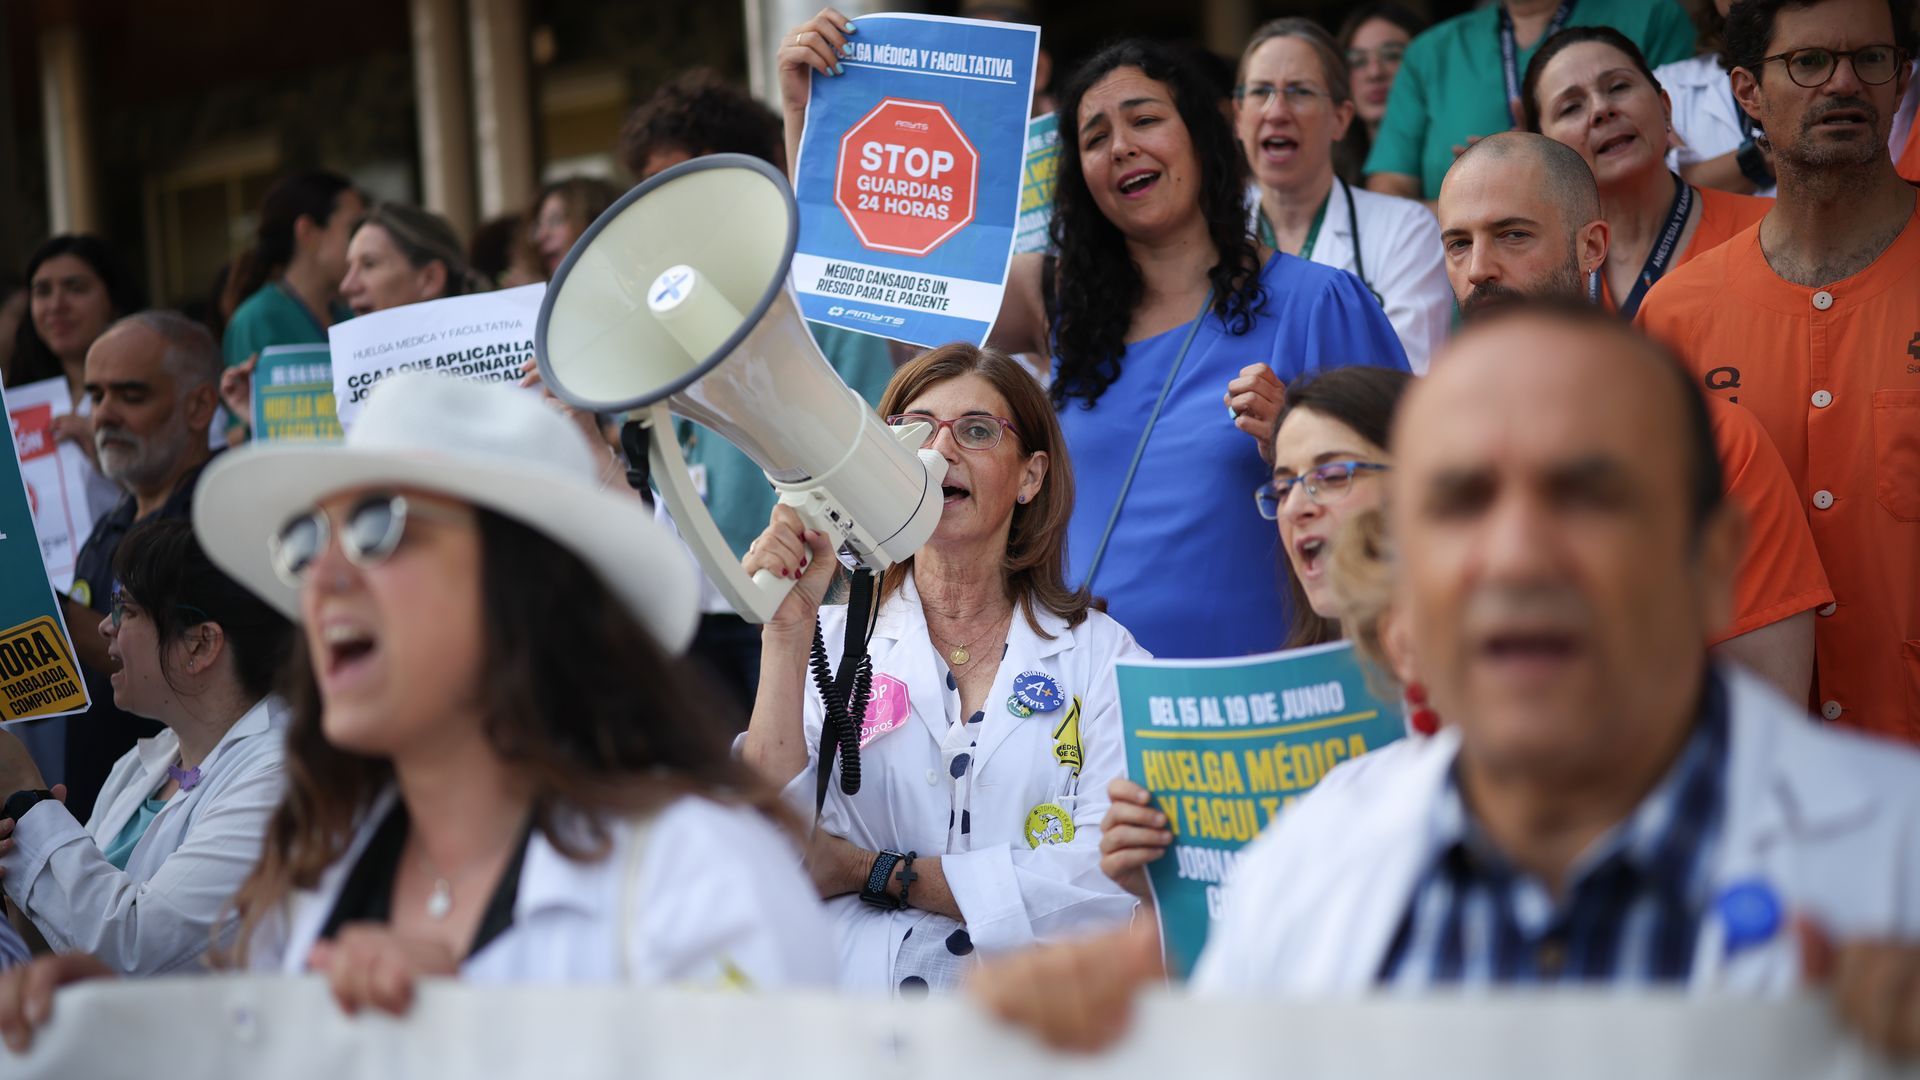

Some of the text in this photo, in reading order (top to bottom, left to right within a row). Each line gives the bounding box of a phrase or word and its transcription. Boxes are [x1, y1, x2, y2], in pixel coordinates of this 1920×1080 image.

[874, 43, 918, 67] MÉDICA
[920, 50, 931, 68] Y
[930, 52, 1013, 78] FACULTATIVA
[860, 141, 954, 180] STOP
[857, 175, 954, 202] GUARDIAS
[858, 194, 949, 221] 24 HORAS
[1652, 221, 1680, 268] ANESTESIA
[816, 278, 950, 311] RIESGO PARA EL PACIENTE
[824, 262, 948, 296] MÉDICO CANSADO ES UN
[843, 308, 906, 326] AMYTS
[353, 343, 394, 360] HUELGA
[440, 331, 448, 342] Y
[449, 319, 523, 338] FACULTATIVA
[435, 342, 511, 368] APLICAN
[514, 340, 535, 352] LA
[1704, 366, 1742, 390] Q
[0, 630, 61, 681] ORA
[1, 665, 69, 701] TRABAJADA
[9, 680, 80, 716] COMPUTADA
[1149, 681, 1346, 727] DEL 15 AL 19 DE JUNIO
[861, 720, 893, 736] DICOS
[1142, 750, 1245, 794] HUELGA
[1157, 796, 1300, 842] Y FACULT
